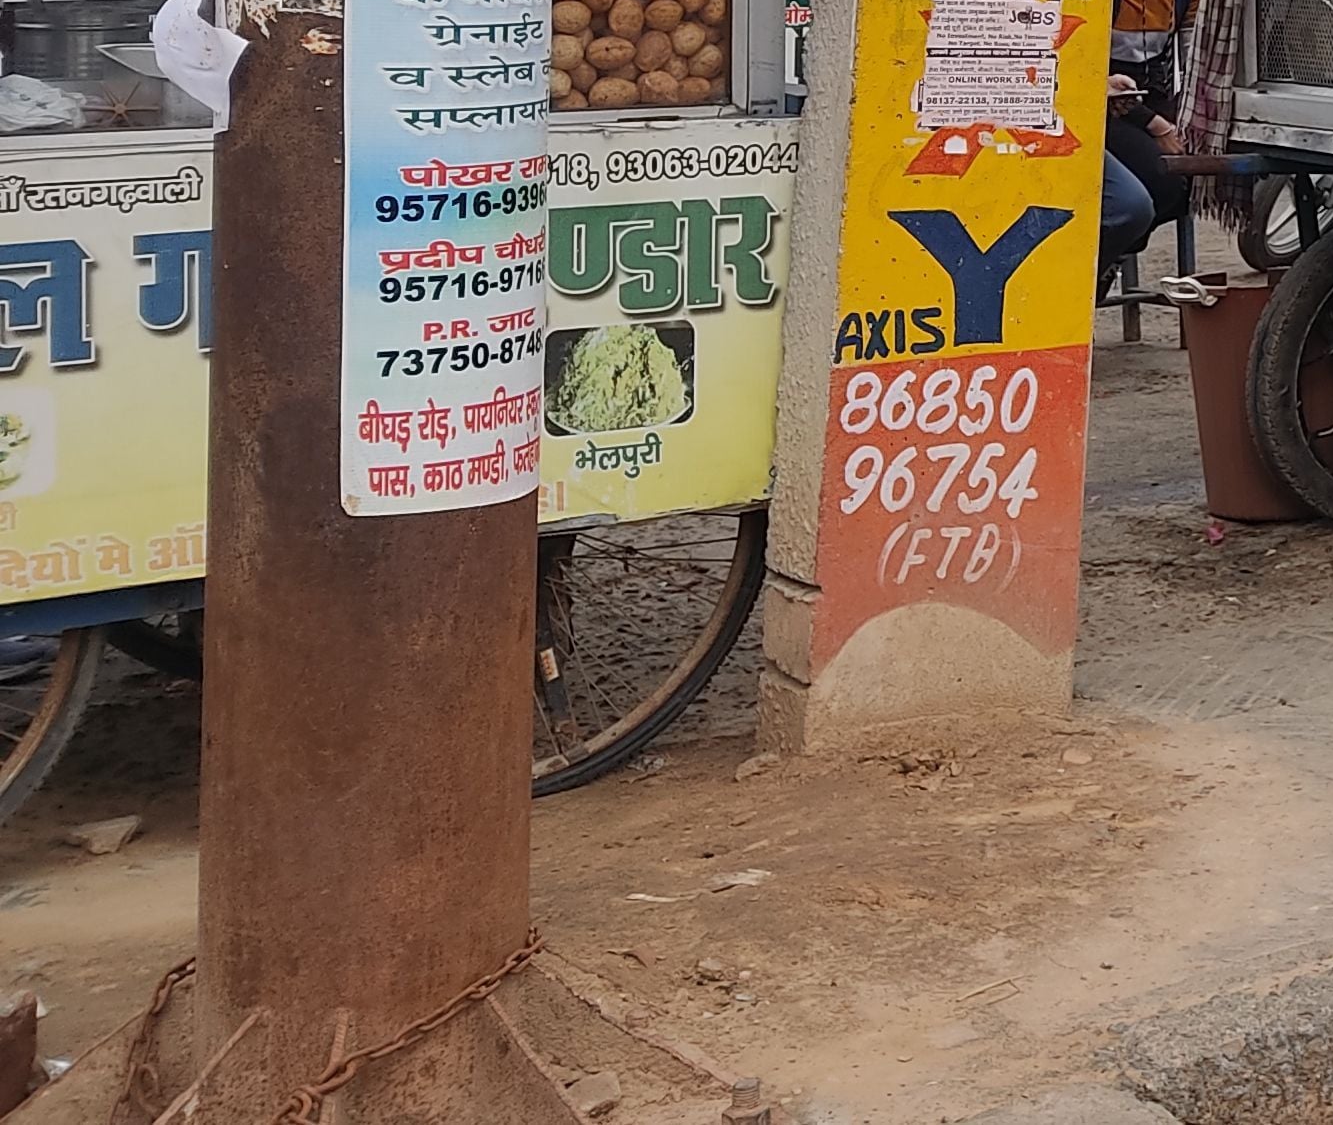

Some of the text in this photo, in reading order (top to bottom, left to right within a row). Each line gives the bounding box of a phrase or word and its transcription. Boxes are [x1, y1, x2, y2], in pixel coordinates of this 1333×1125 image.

[423, 12, 543, 48] ग्रेनाईट
[382, 55, 535, 88] व स्लेब
[948, 76, 982, 84] ONLINE
[986, 76, 1012, 84] WORK
[400, 159, 514, 188] पोखर
[548, 141, 800, 190] 18, 93063-02044
[375, 180, 546, 223] 95716-9396
[378, 239, 486, 275] प्रदीप
[548, 195, 780, 314] ण्डार
[887, 205, 1075, 345] Y
[423, 307, 536, 342] P.R. जाट
[833, 307, 946, 364] AXIS
[376, 330, 543, 377] 73750-8748
[840, 366, 1039, 437] 86850
[575, 431, 663, 479] भेलपुरी
[840, 441, 1039, 520] 96754
